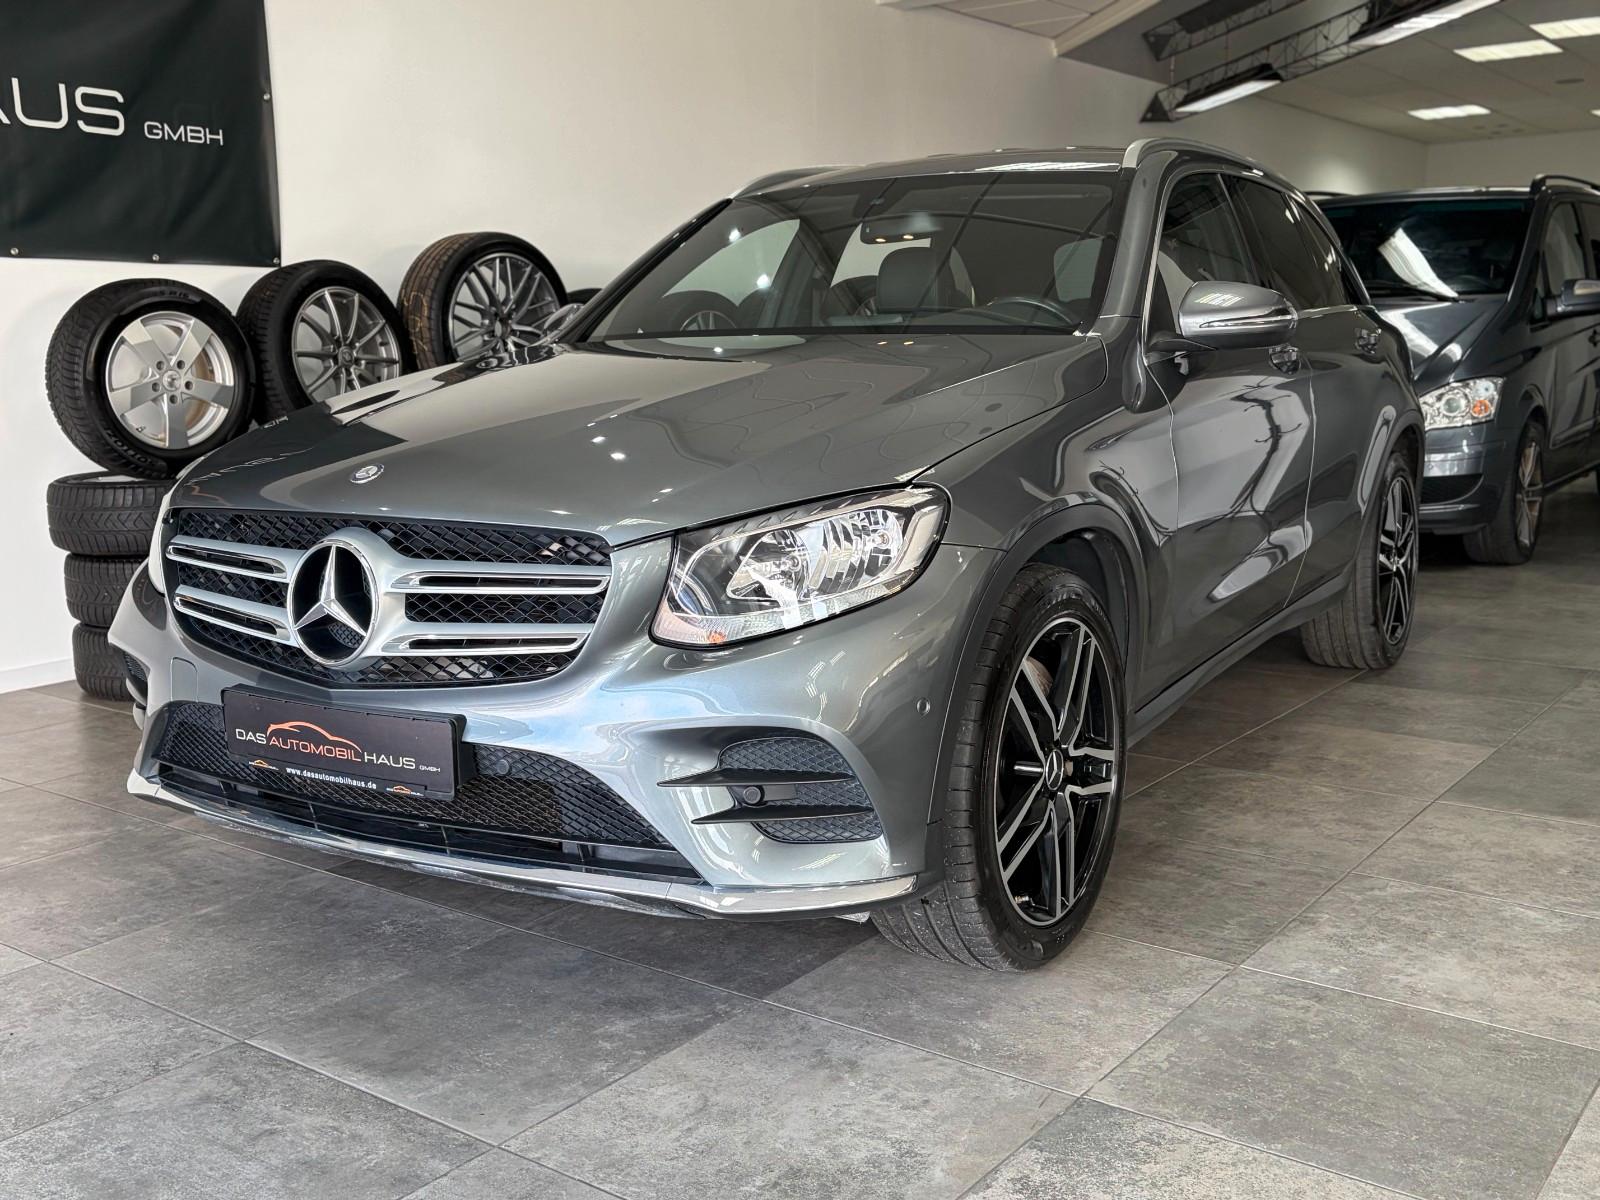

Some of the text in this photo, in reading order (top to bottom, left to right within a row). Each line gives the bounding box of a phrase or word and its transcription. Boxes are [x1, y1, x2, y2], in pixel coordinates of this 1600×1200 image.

[0, 77, 223, 145] US GMBH
[235, 728, 441, 773] DAS AUTOMOBIL HAUS GMBH
[285, 766, 377, 790] www.dasautomobilhaus.de
